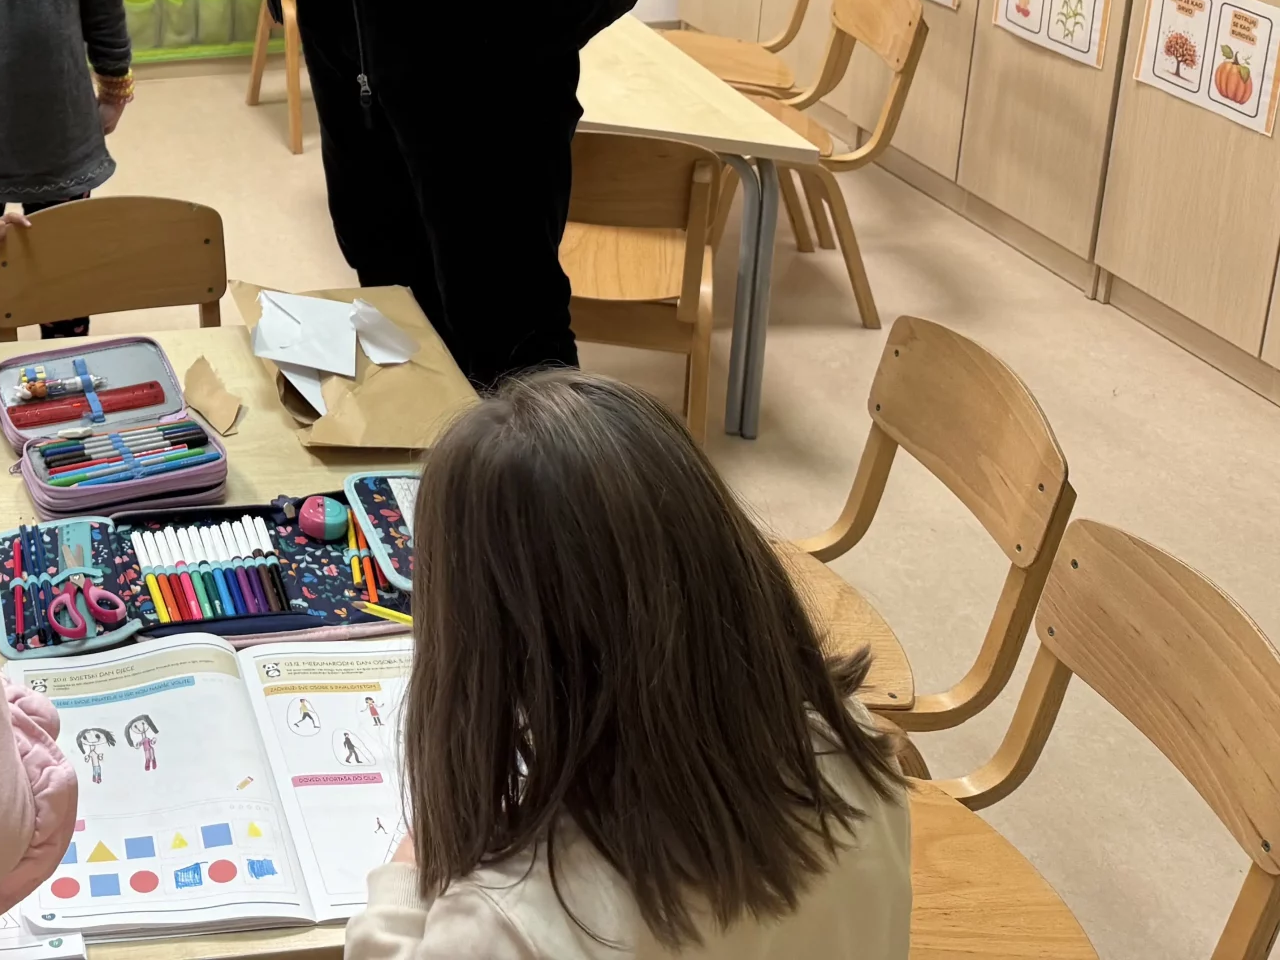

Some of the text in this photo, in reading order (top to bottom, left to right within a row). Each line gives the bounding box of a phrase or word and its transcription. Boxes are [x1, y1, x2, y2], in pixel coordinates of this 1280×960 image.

[1239, 23, 1251, 32] KAO
[356, 659, 372, 667] DAN
[372, 658, 398, 666] OSOBA
[69, 673, 99, 682] SVJETSKI
[99, 670, 114, 679] DAN
[115, 665, 135, 675] DJECE
